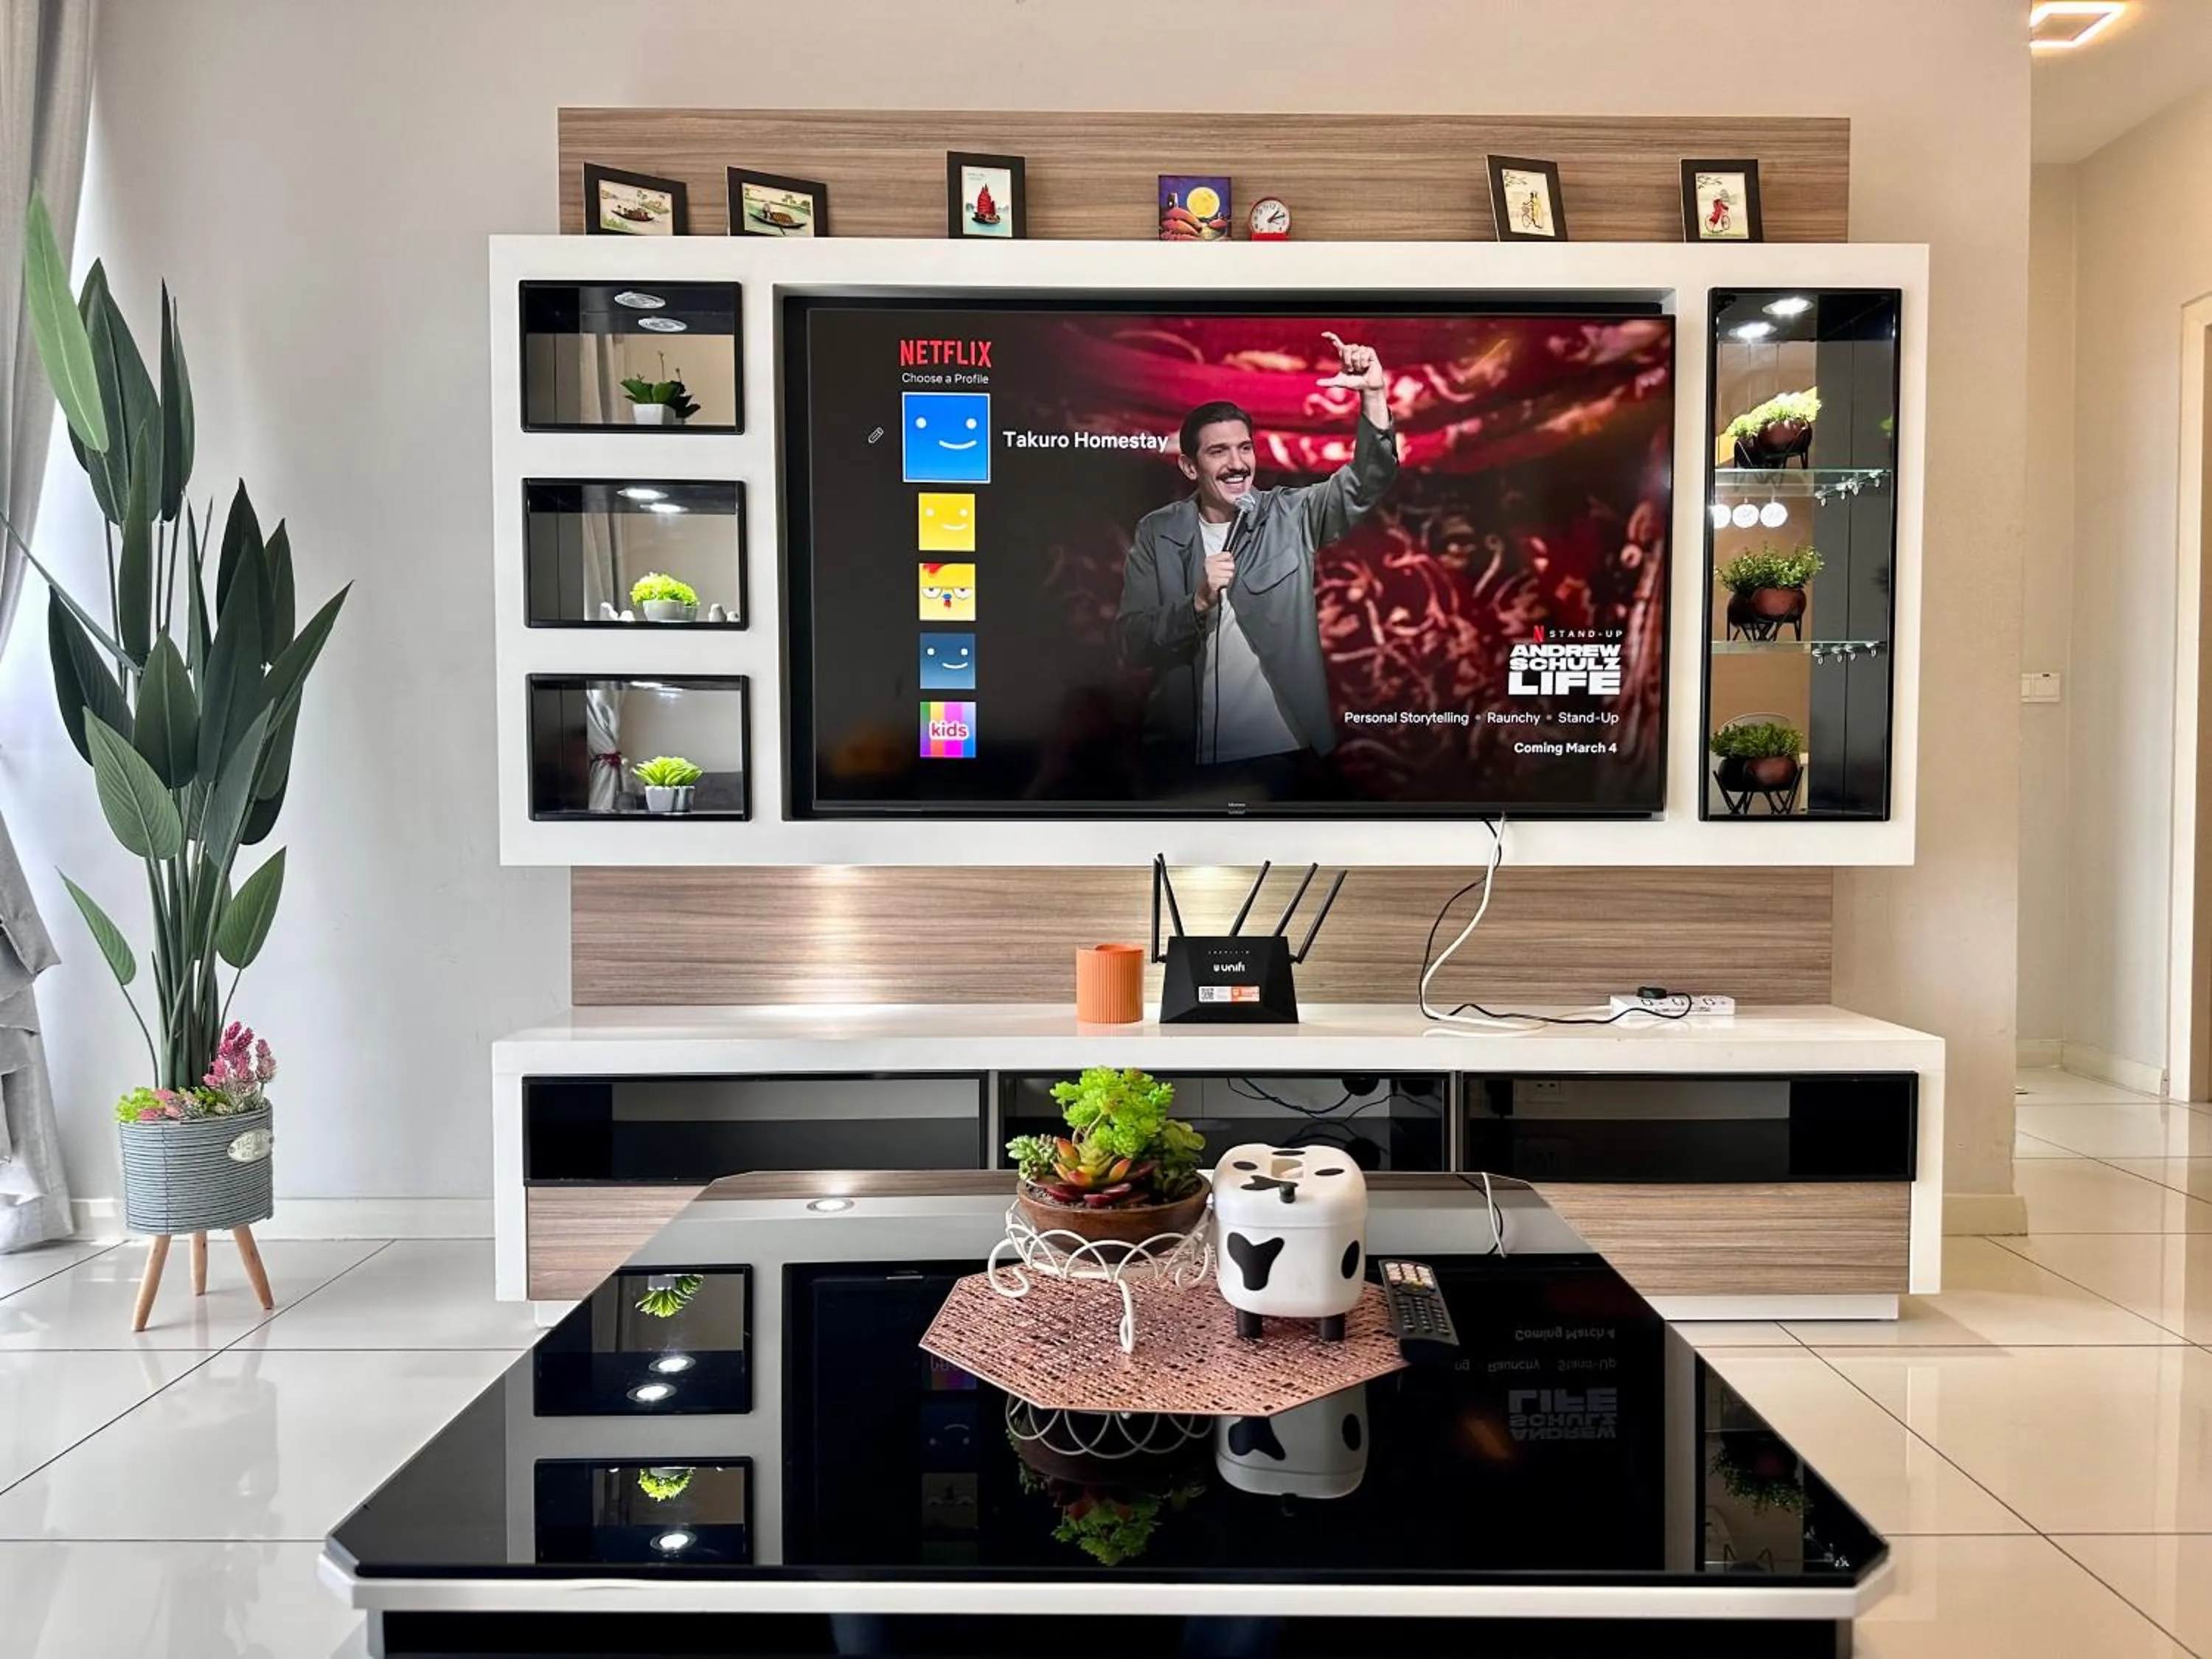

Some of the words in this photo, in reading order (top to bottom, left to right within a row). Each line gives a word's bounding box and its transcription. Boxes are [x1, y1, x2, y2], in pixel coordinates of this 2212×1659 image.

[900, 340, 992, 367] NETFLIX
[902, 372, 943, 384] Choose
[945, 375, 952, 384] a
[954, 372, 989, 384] Profile
[1003, 431, 1070, 449] Takuro
[1074, 431, 1169, 453] Homestay
[1549, 630, 1623, 639] STAND-UP
[1510, 644, 1621, 657] ANDREW
[1509, 657, 1621, 671] SCHULZ
[1508, 671, 1621, 695] LIFE
[1344, 712, 1397, 724] Personal
[1399, 712, 1470, 726] Storytelling
[1487, 712, 1541, 726] Raunchy
[1558, 712, 1619, 726] Stand-Up
[931, 722, 967, 737] kids
[1514, 742, 1563, 756] Coming
[1565, 742, 1606, 754] March
[1608, 742, 1617, 754] 4
